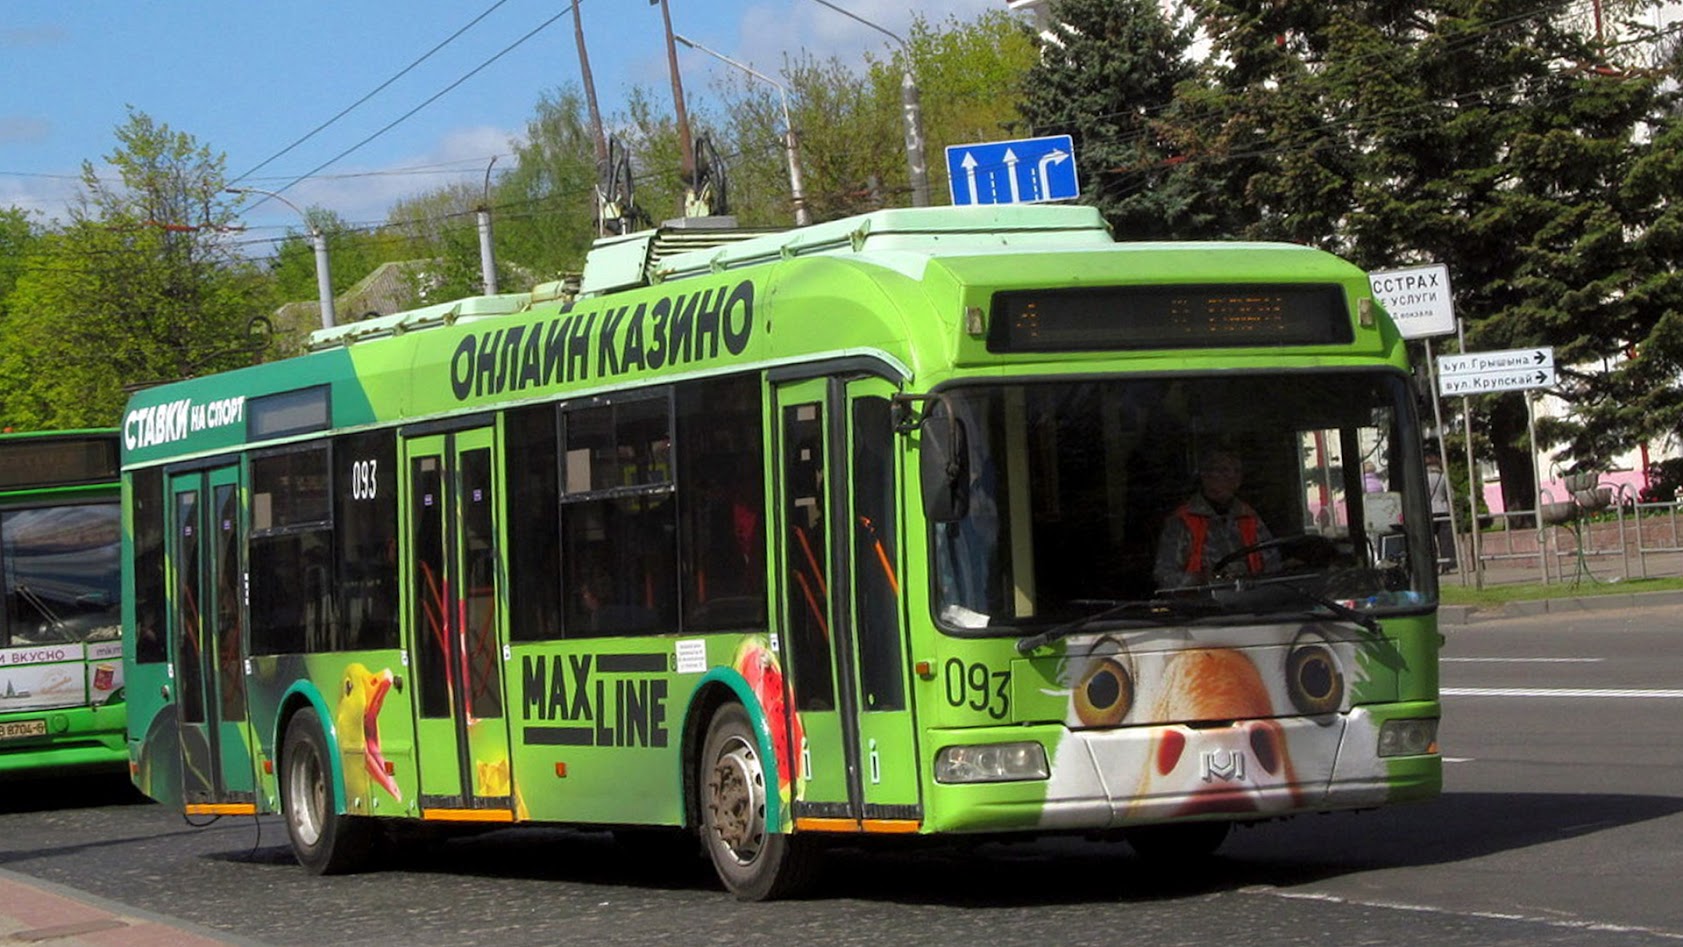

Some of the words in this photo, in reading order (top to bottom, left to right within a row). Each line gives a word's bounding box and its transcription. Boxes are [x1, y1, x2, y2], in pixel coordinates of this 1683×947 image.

[1391, 292, 1437, 306] УСЛУГИ
[451, 302, 596, 400] ОНЛАЙН
[597, 280, 755, 378] КАЗИНО
[125, 398, 191, 450] СТАВКИ
[191, 404, 206, 431] НА
[207, 396, 246, 428] СПОРТ
[353, 460, 377, 499] 093
[12, 650, 65, 663] ВКУСНО
[523, 654, 593, 720] MAX
[596, 679, 668, 748] LINE
[945, 657, 1011, 719] 093
